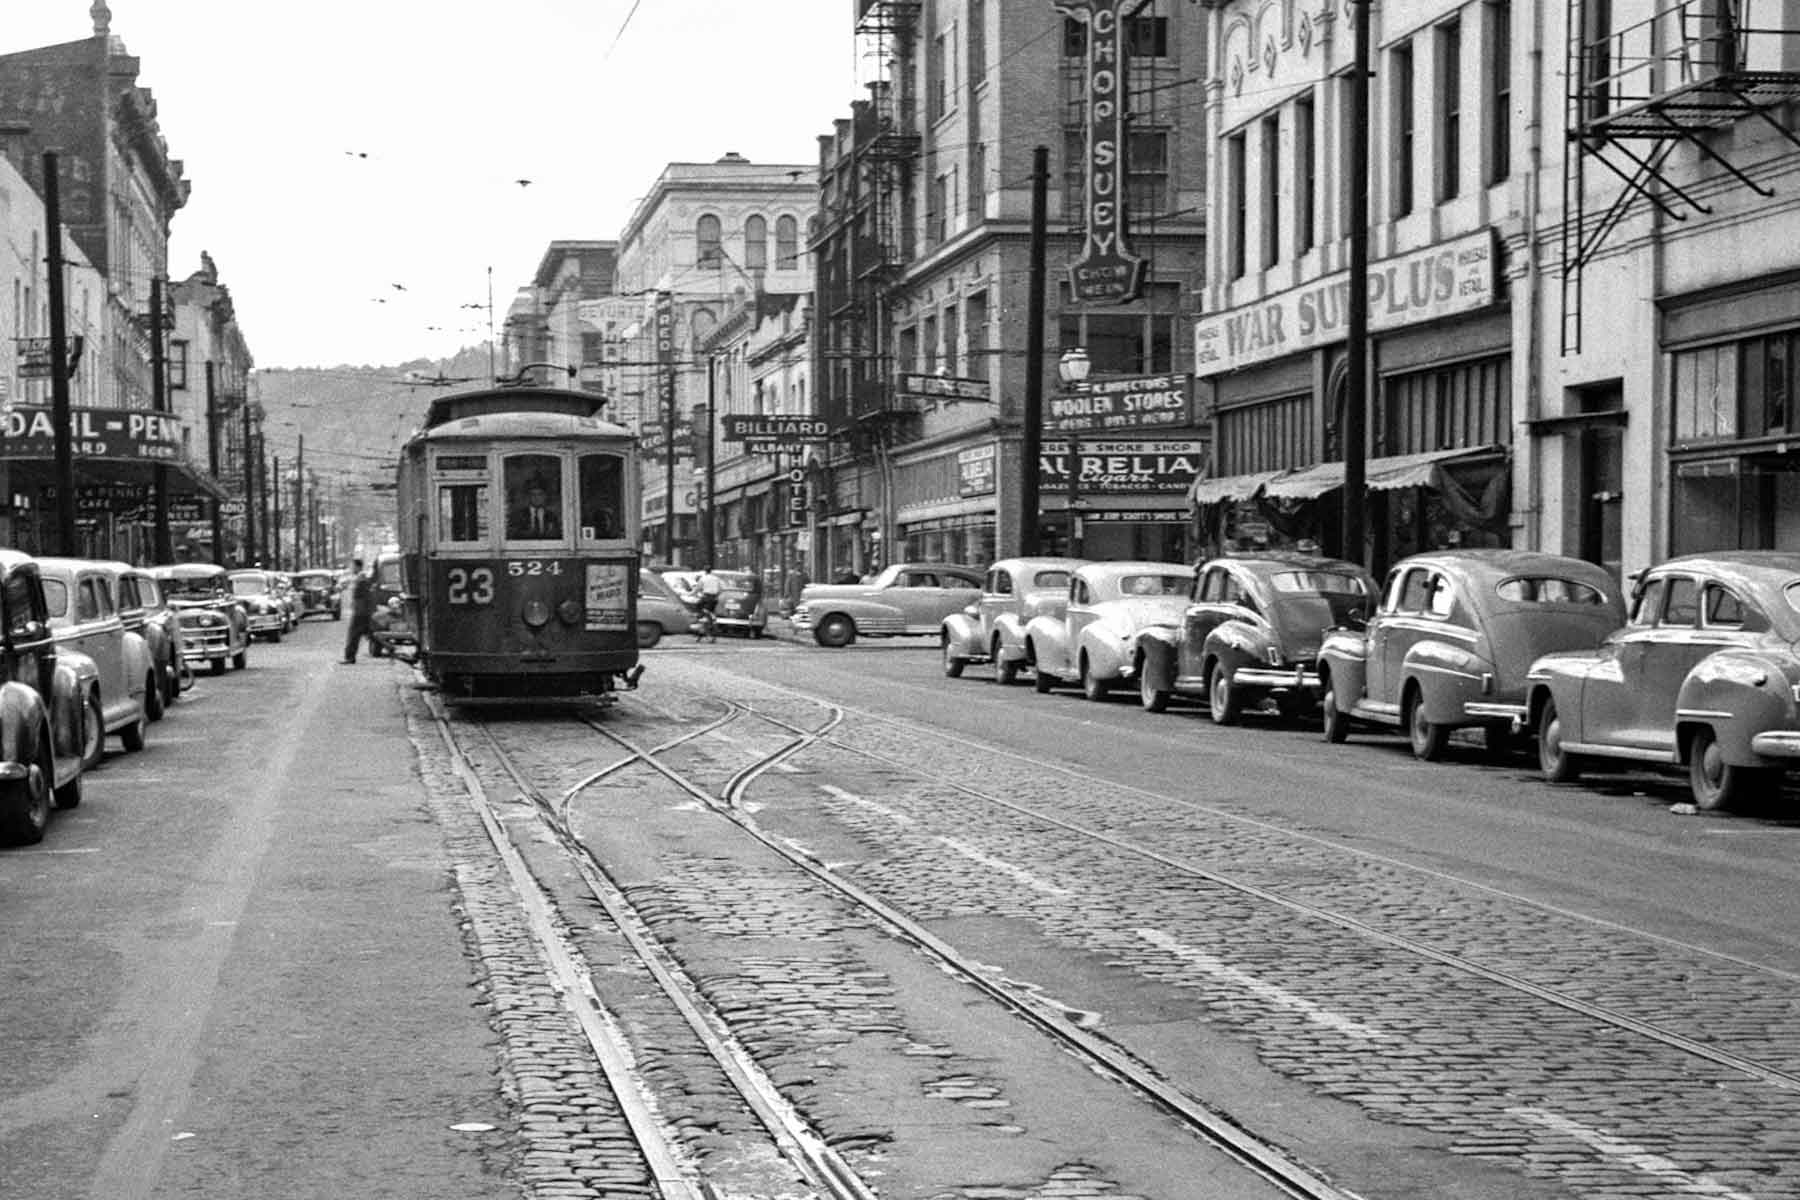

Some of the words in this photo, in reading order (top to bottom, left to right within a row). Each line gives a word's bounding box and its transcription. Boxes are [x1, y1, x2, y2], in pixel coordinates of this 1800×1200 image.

[1093, 8, 1115, 123] CHOP
[1092, 140, 1115, 256] SUEY
[1225, 303, 1287, 356] WAR
[1123, 390, 1184, 412] STORES
[735, 421, 828, 435] BILLIARD
[1096, 443, 1144, 452] SMOKE
[1153, 443, 1192, 452] SHOP
[790, 455, 803, 525] HOTEL
[1078, 471, 1156, 488] Cigars
[218, 503, 246, 513] ADIO
[508, 561, 562, 575] 524
[448, 568, 494, 604] 23
